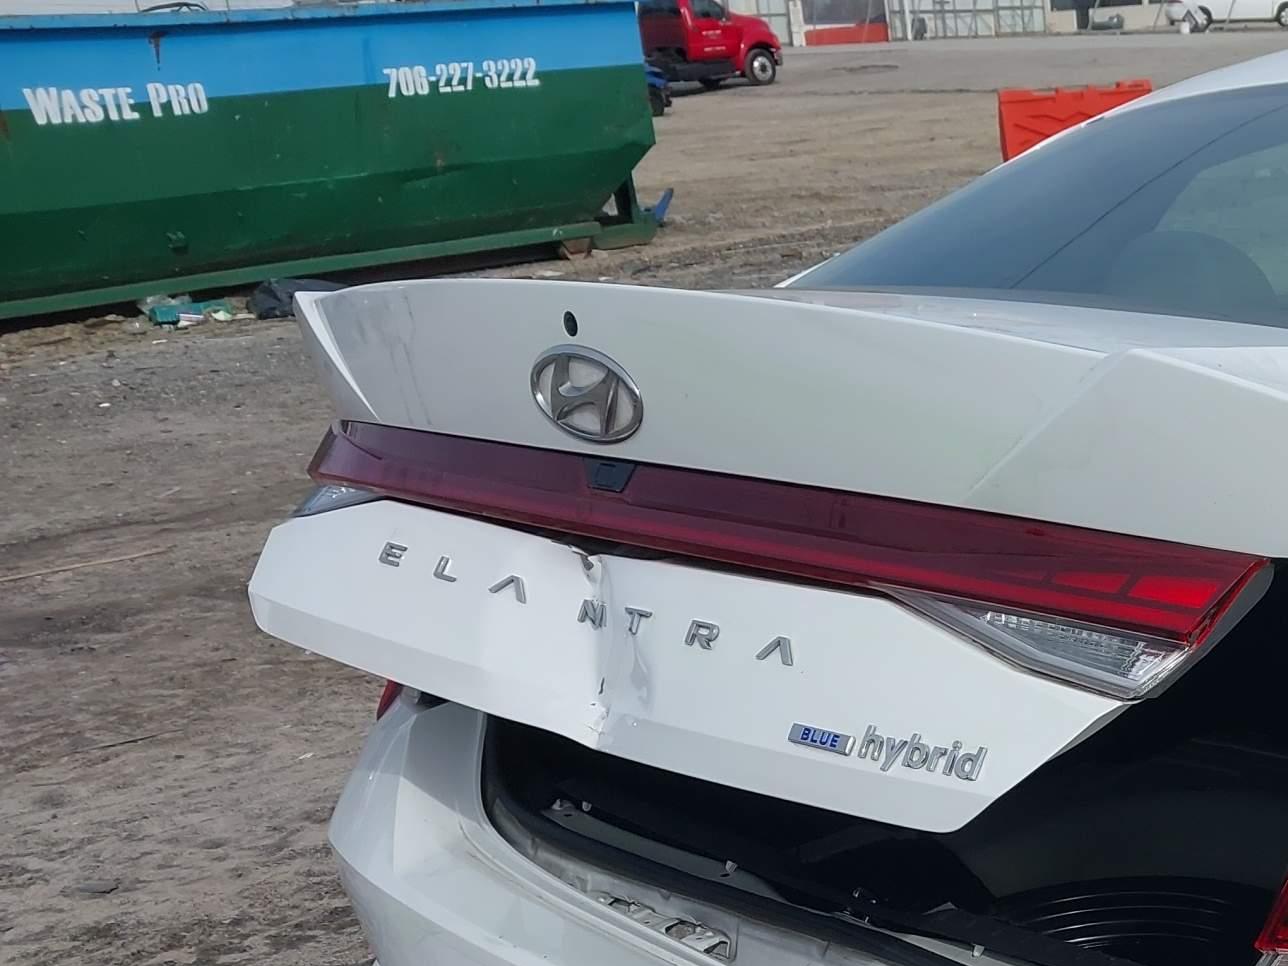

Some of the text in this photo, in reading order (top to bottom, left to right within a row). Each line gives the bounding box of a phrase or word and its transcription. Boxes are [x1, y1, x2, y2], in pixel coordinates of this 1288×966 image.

[382, 57, 540, 98] 706-227-3222
[378, 541, 794, 667] ELANTRA
[800, 724, 988, 782] BLUE hybrid
